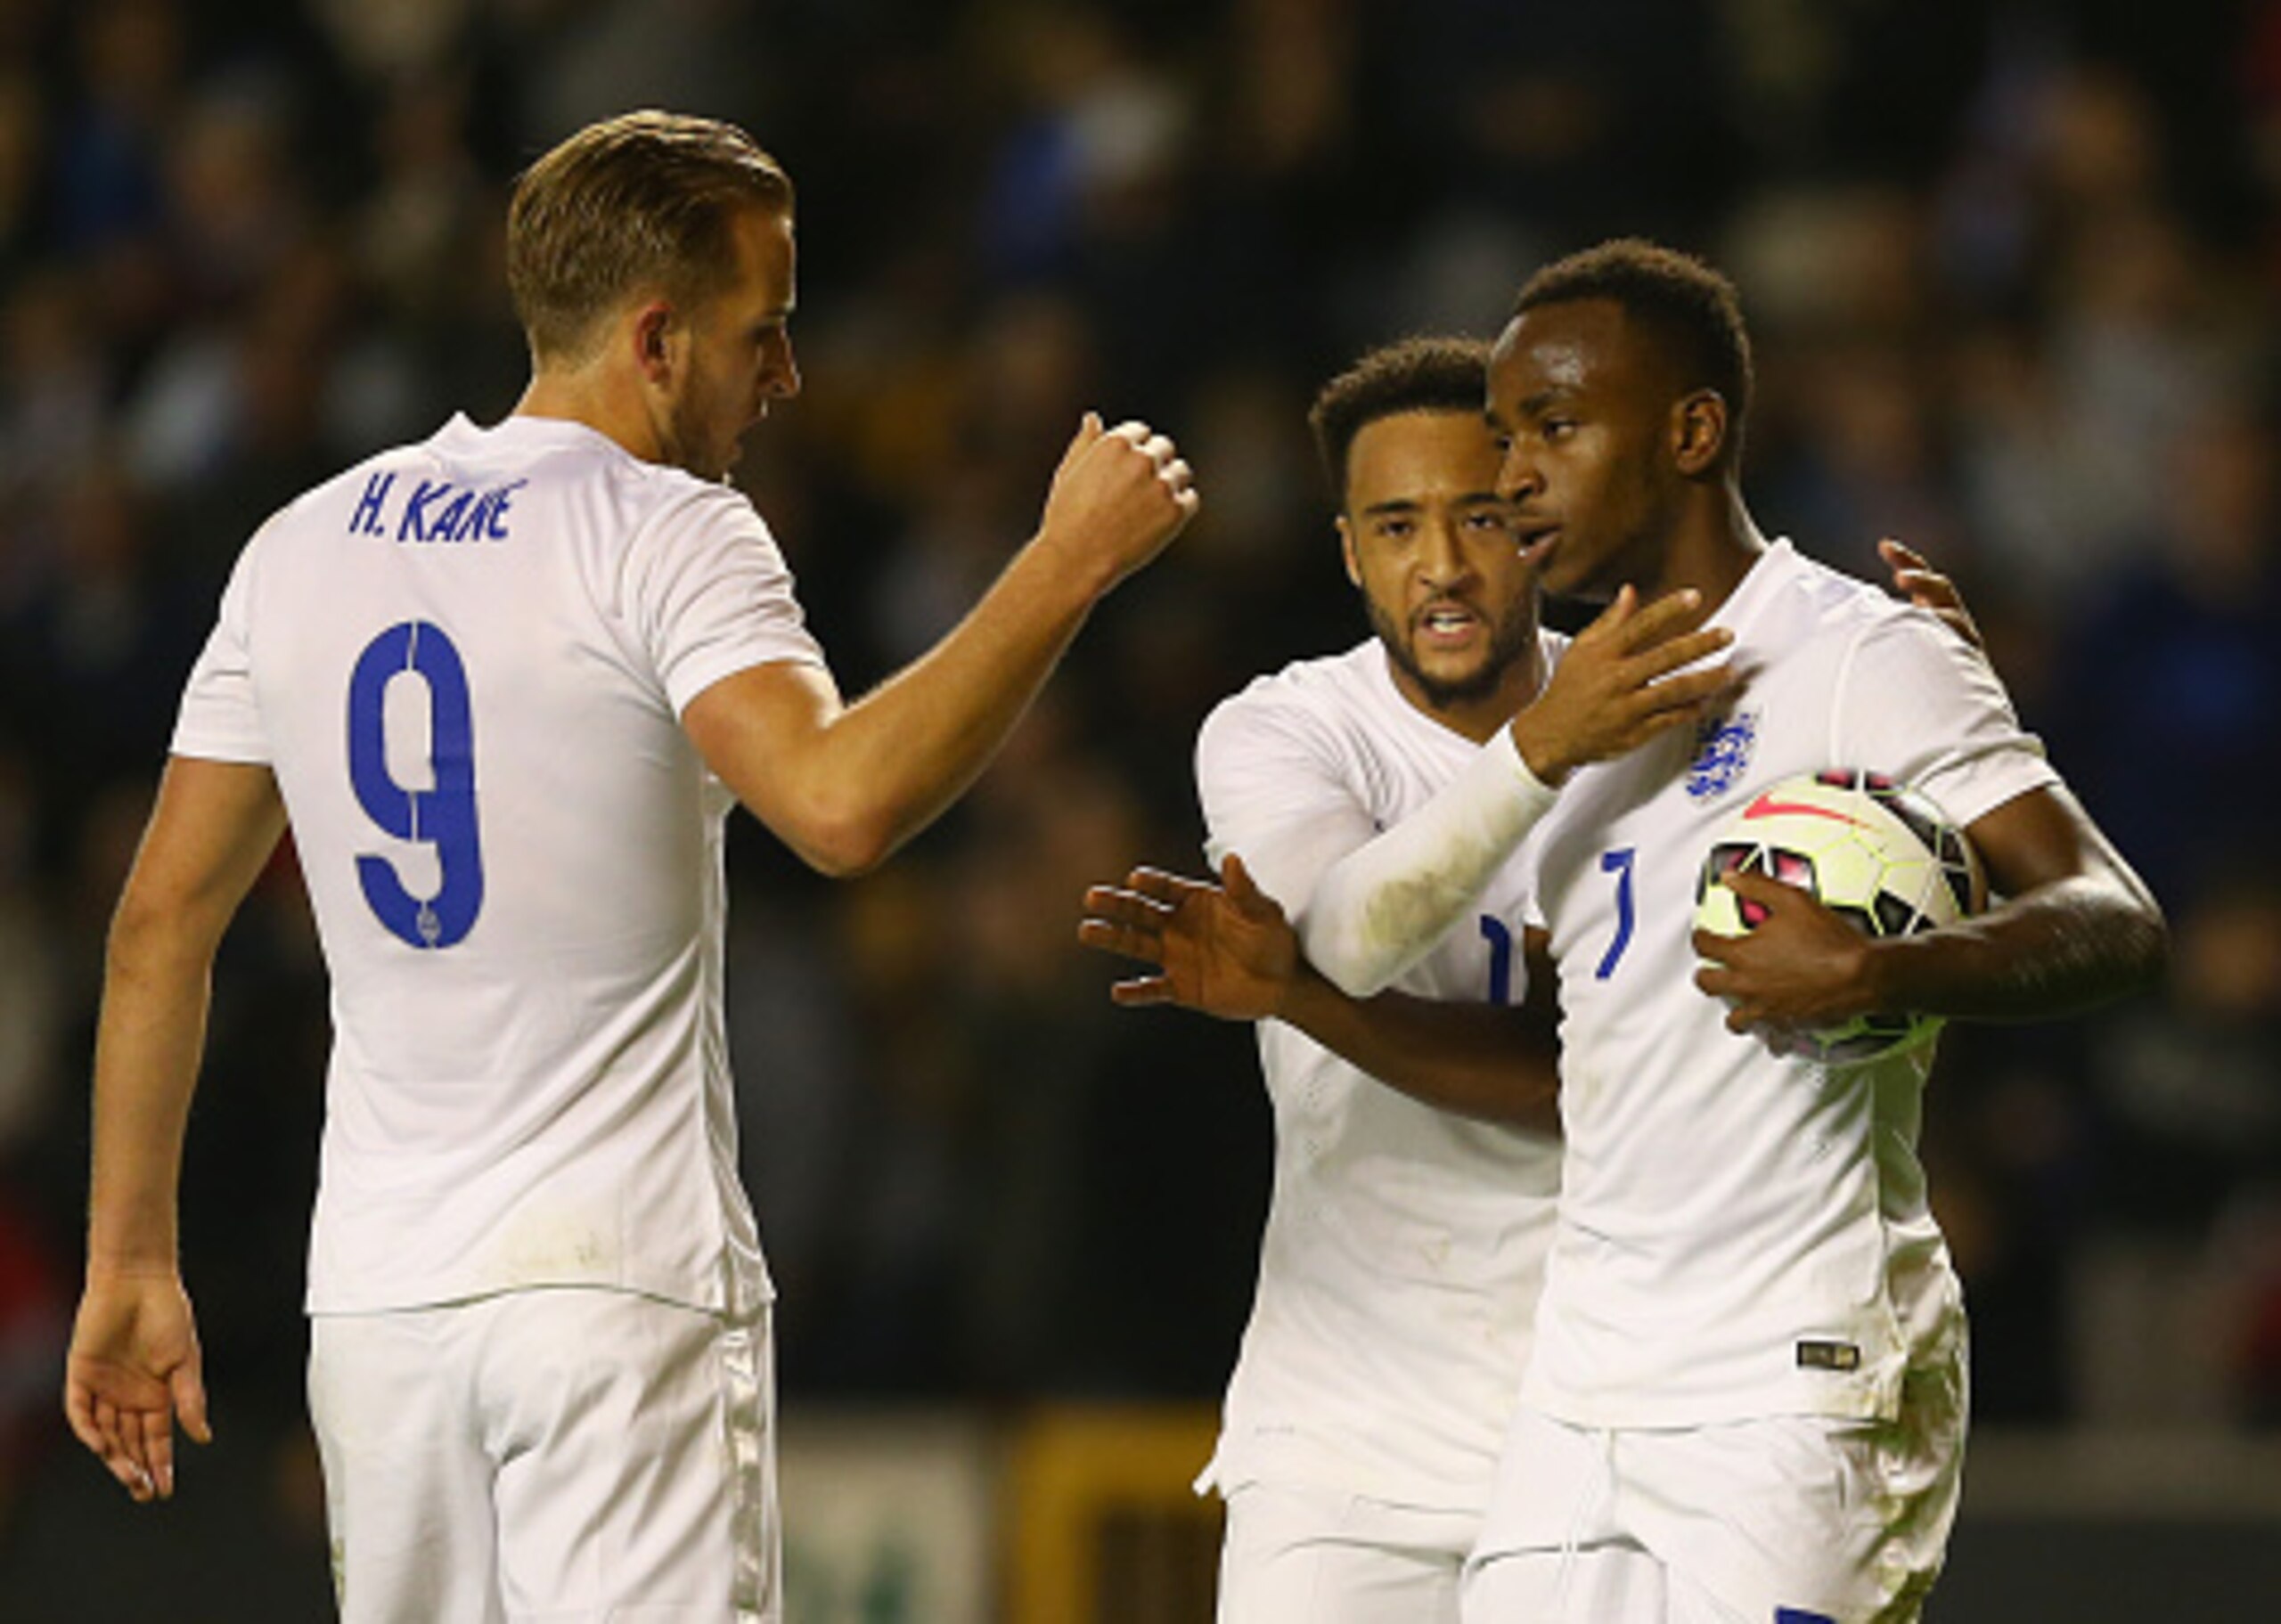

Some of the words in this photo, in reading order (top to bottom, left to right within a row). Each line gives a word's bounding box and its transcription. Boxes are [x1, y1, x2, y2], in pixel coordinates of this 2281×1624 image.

[348, 471, 395, 536] H.
[397, 480, 527, 542] KANE
[347, 619, 485, 949] 9
[1595, 847, 1635, 981] 7
